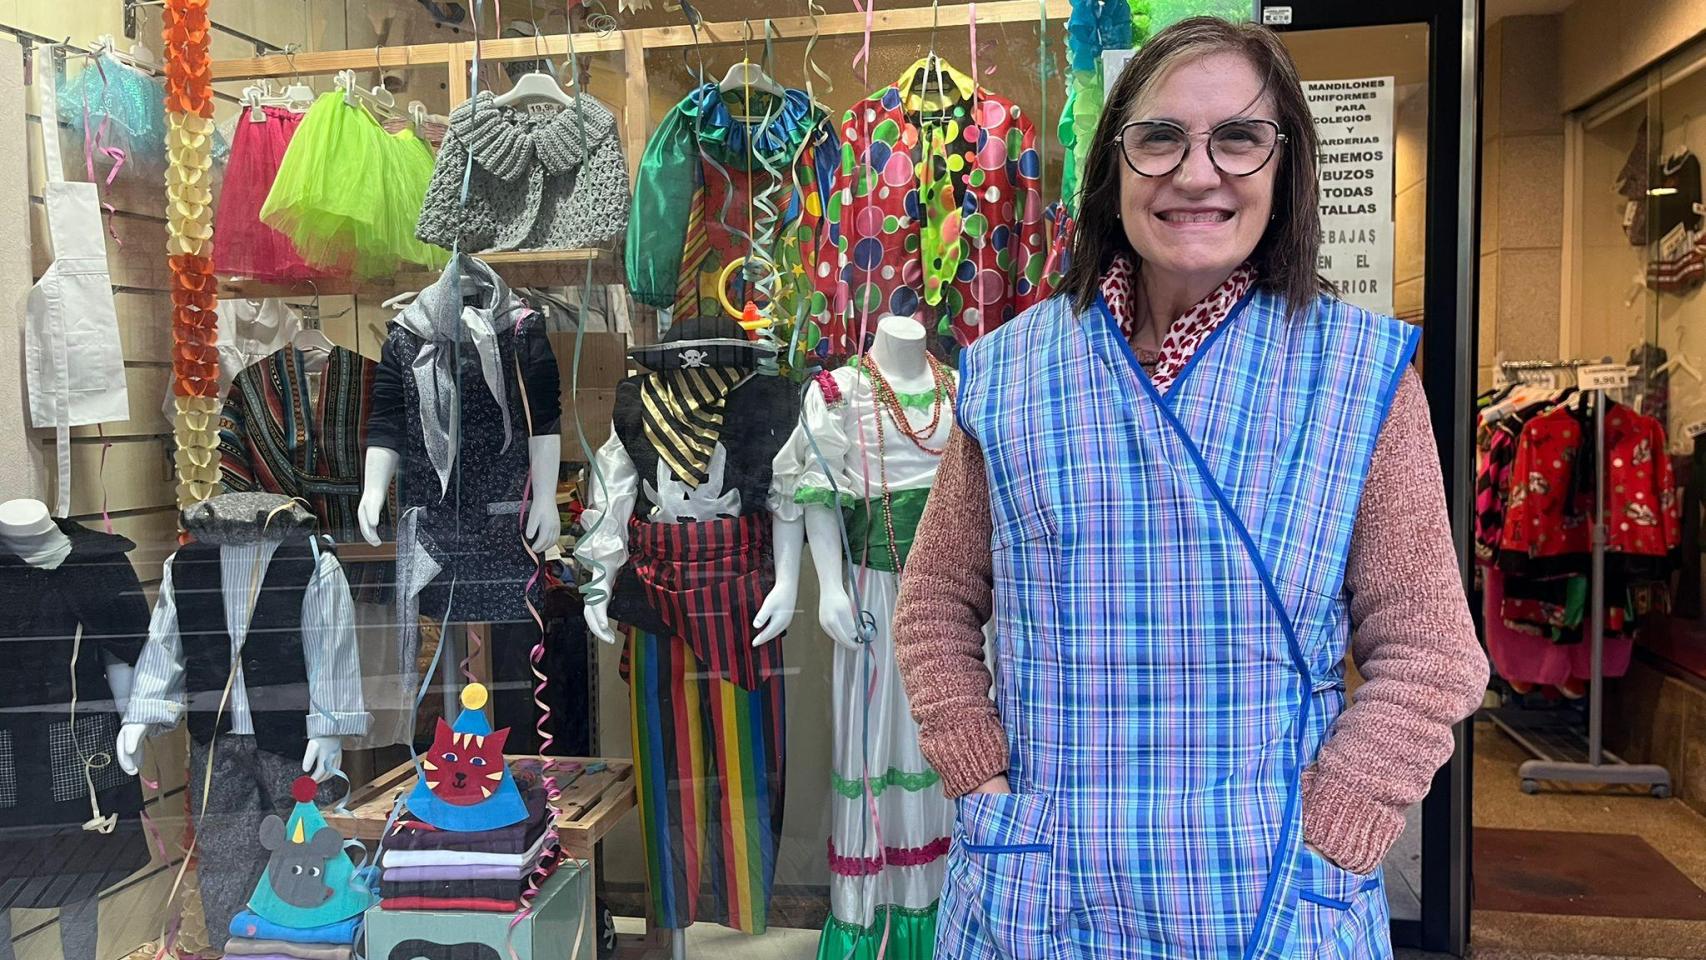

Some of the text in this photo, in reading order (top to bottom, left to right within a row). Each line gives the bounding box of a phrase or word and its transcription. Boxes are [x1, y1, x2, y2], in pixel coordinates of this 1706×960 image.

[1308, 80, 1385, 91] MANDILONES
[1308, 92, 1377, 102] UNIFORMES
[1335, 104, 1366, 112] PARA
[1313, 115, 1372, 124] COLEGIOS
[1346, 126, 1354, 134] Y
[1319, 137, 1380, 146] ARDERIAS
[1322, 169, 1374, 181] BUZOS
[1322, 187, 1374, 198] TODAS
[1319, 203, 1377, 215] TALLAS
[1319, 229, 1376, 245] EBAJAS
[1317, 254, 1370, 269] EN EL
